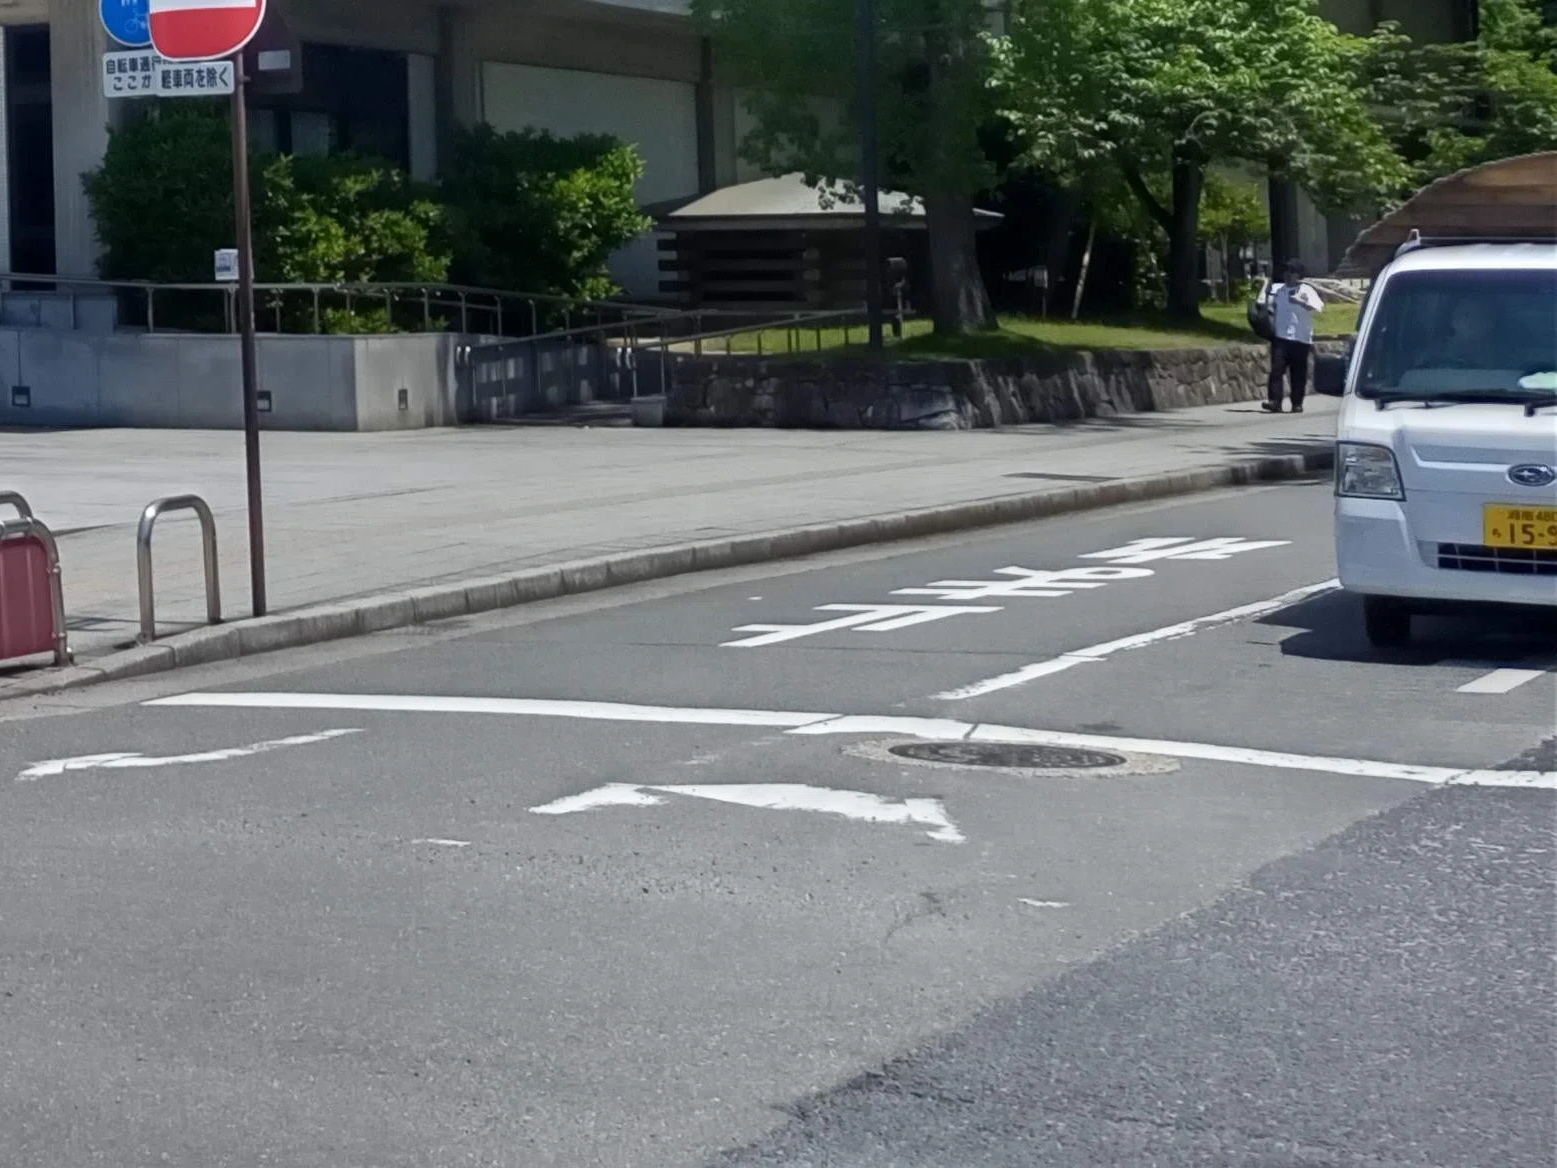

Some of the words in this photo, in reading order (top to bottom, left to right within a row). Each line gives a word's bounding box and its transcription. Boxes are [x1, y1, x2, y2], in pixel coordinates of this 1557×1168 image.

[161, 66, 229, 89] 軽車両を除く
[719, 537, 1292, 648] 止まれ
